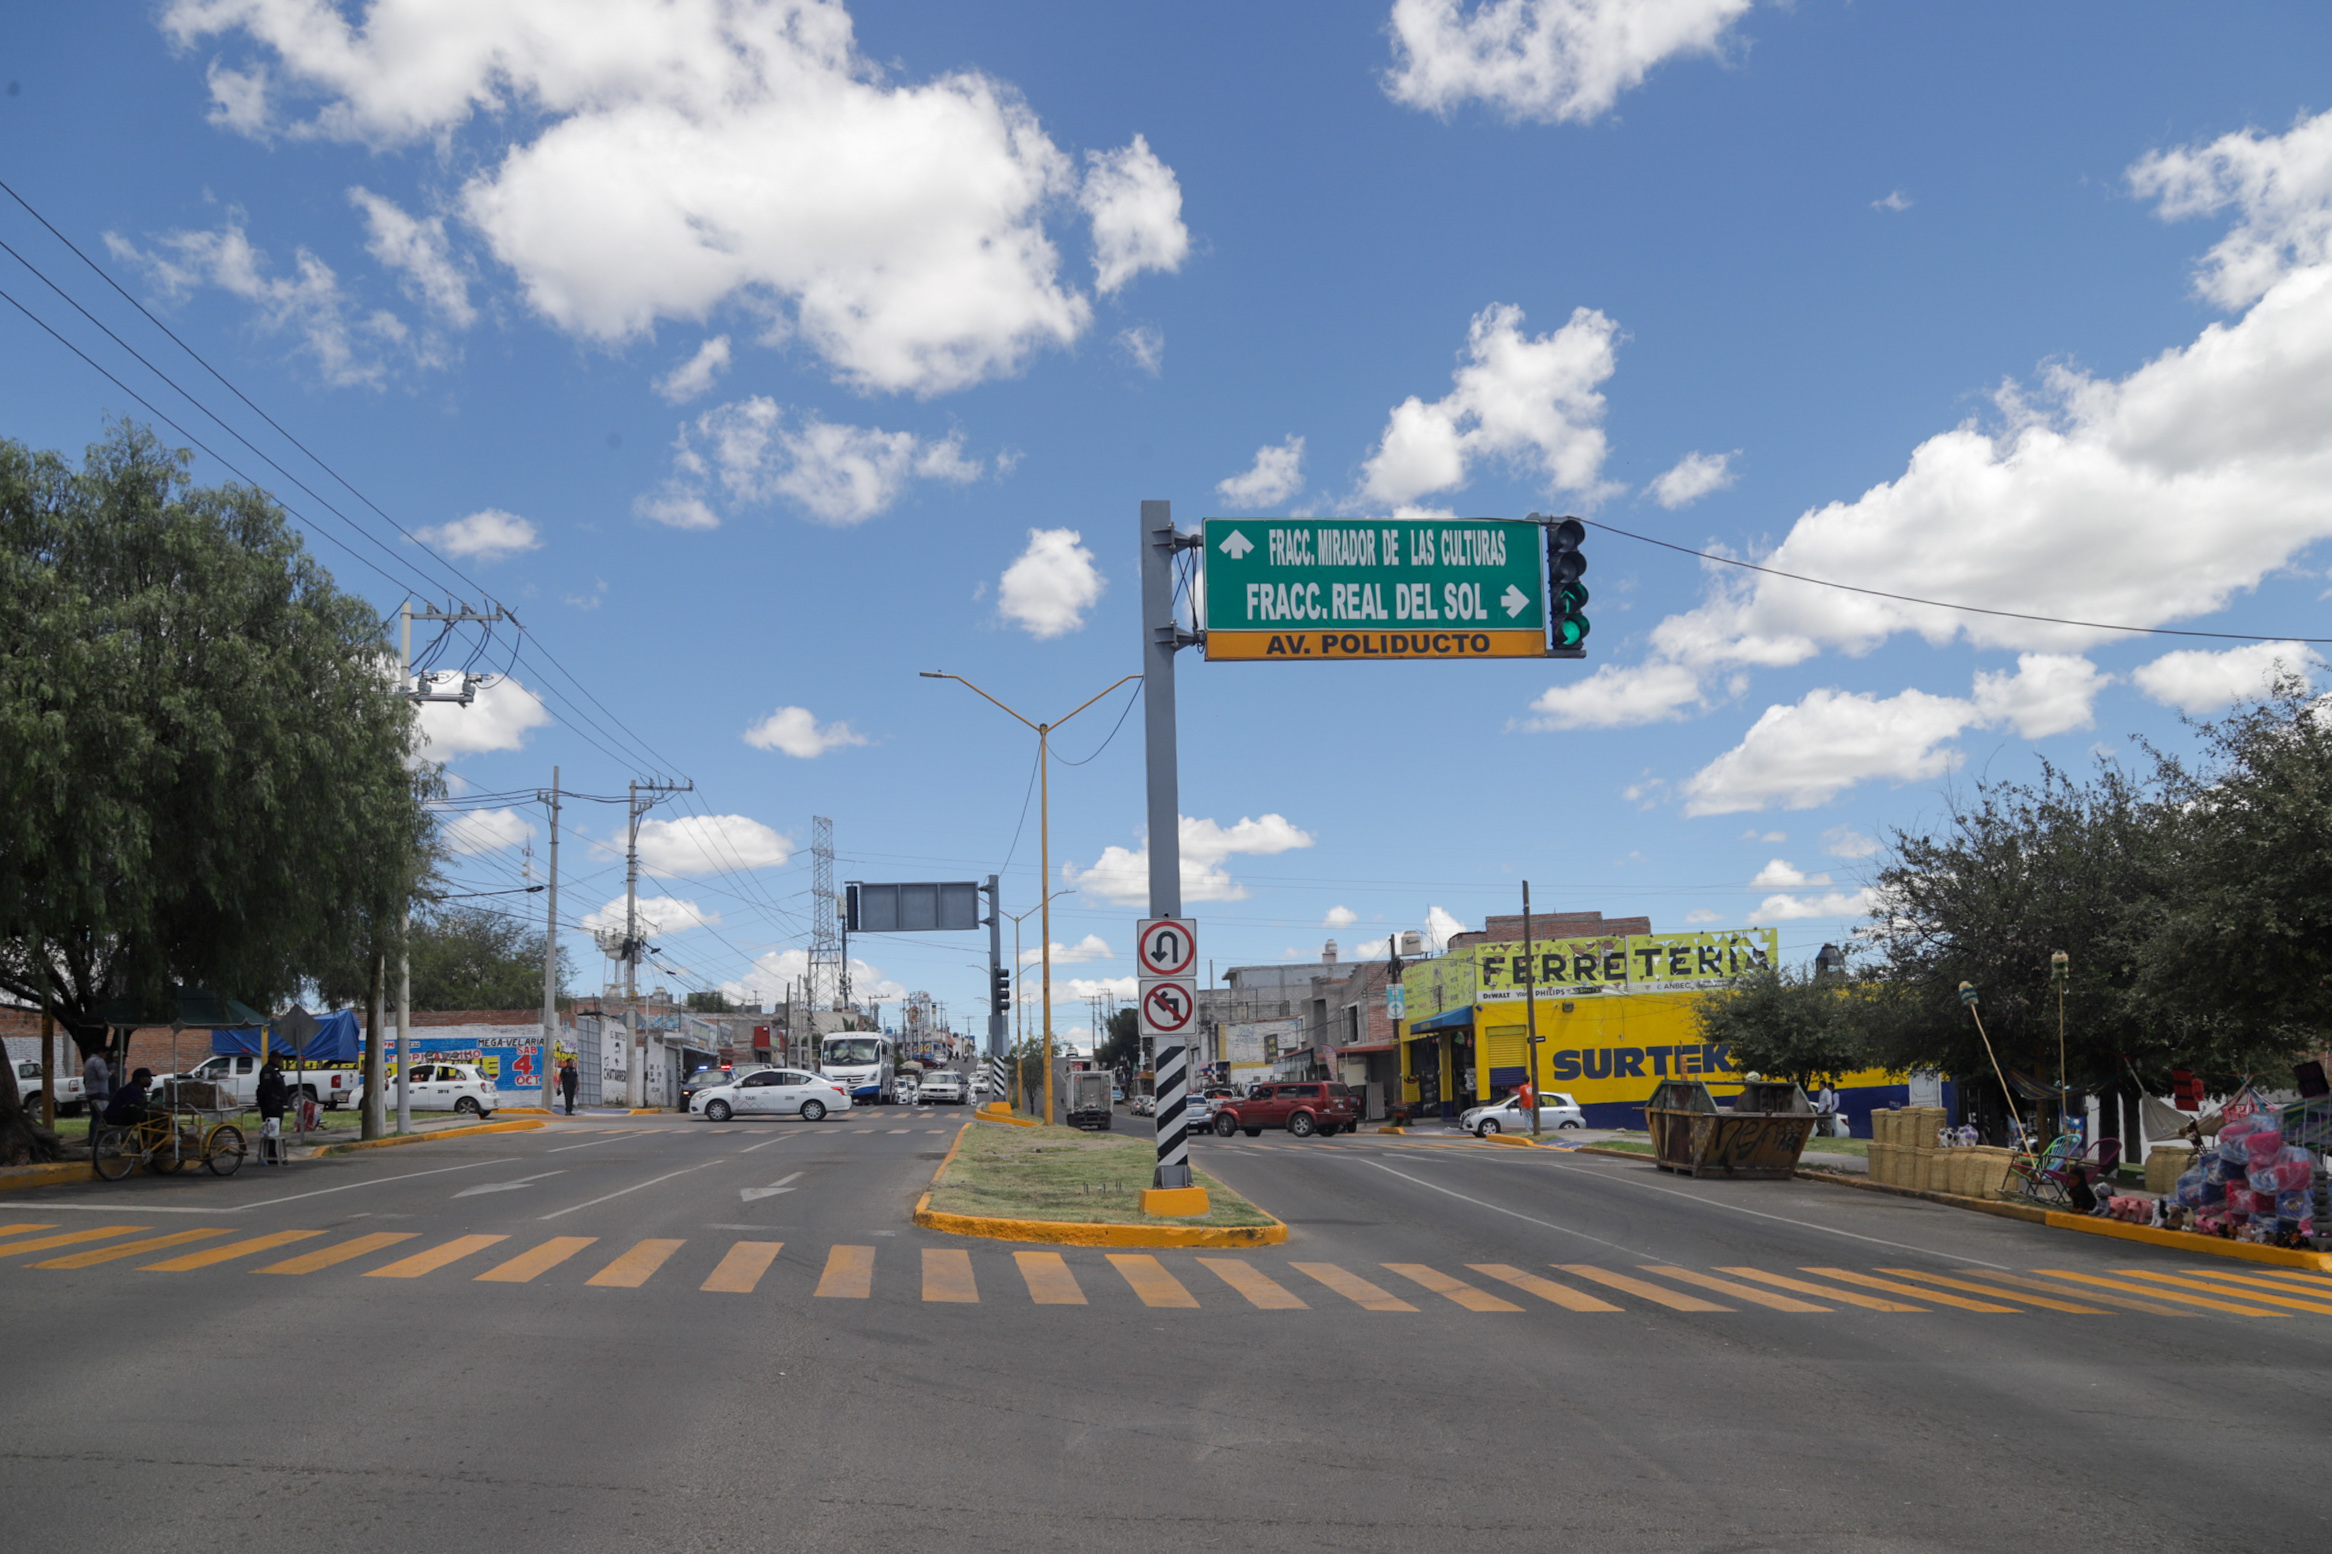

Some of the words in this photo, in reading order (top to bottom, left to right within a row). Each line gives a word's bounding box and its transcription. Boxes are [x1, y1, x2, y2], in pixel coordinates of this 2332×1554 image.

[1268, 528, 1315, 566] FRACC.
[1317, 528, 1376, 566] MIRADOR
[1382, 529, 1399, 566] DE
[1410, 529, 1435, 566] LAS
[1440, 529, 1506, 566] CULTURAS
[1246, 582, 1328, 620] FRACC.
[1332, 583, 1388, 620] REAL
[1395, 583, 1438, 620] DEL
[1444, 582, 1487, 620] SOL
[1265, 635, 1311, 655] AV.
[1321, 633, 1490, 654] POLIDUCTO
[1535, 989, 1565, 997] PHILIPS
[516, 1046, 537, 1054] SAB
[514, 1055, 533, 1075] 4
[1552, 1044, 1736, 1081] SURTEK
